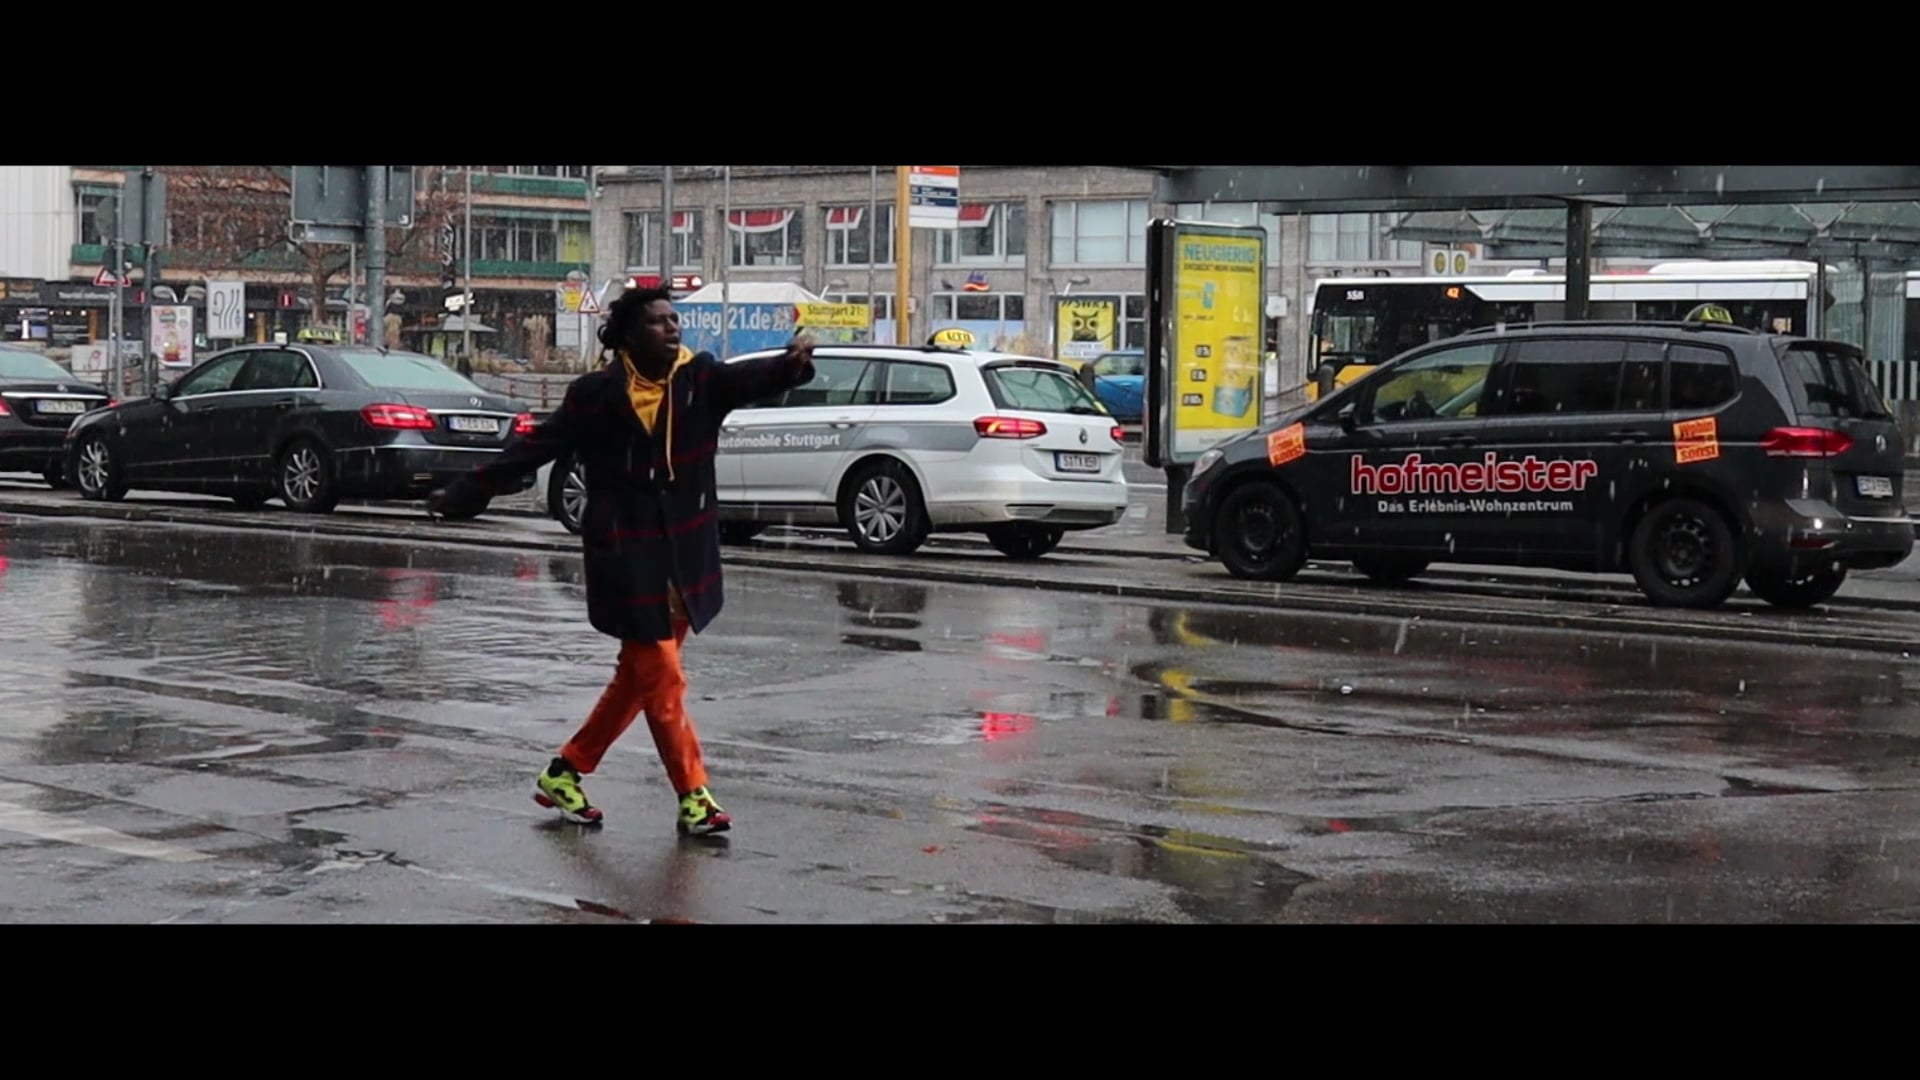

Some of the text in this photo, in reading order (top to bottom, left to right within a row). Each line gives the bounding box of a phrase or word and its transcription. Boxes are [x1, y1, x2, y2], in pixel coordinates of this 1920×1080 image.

[1184, 243, 1256, 263] NEUGIERIG
[783, 433, 840, 449] Stuttgart
[1351, 452, 1598, 495] hofmeister
[1377, 499, 1574, 514] Das Erlebnis-Wohnzentrum
